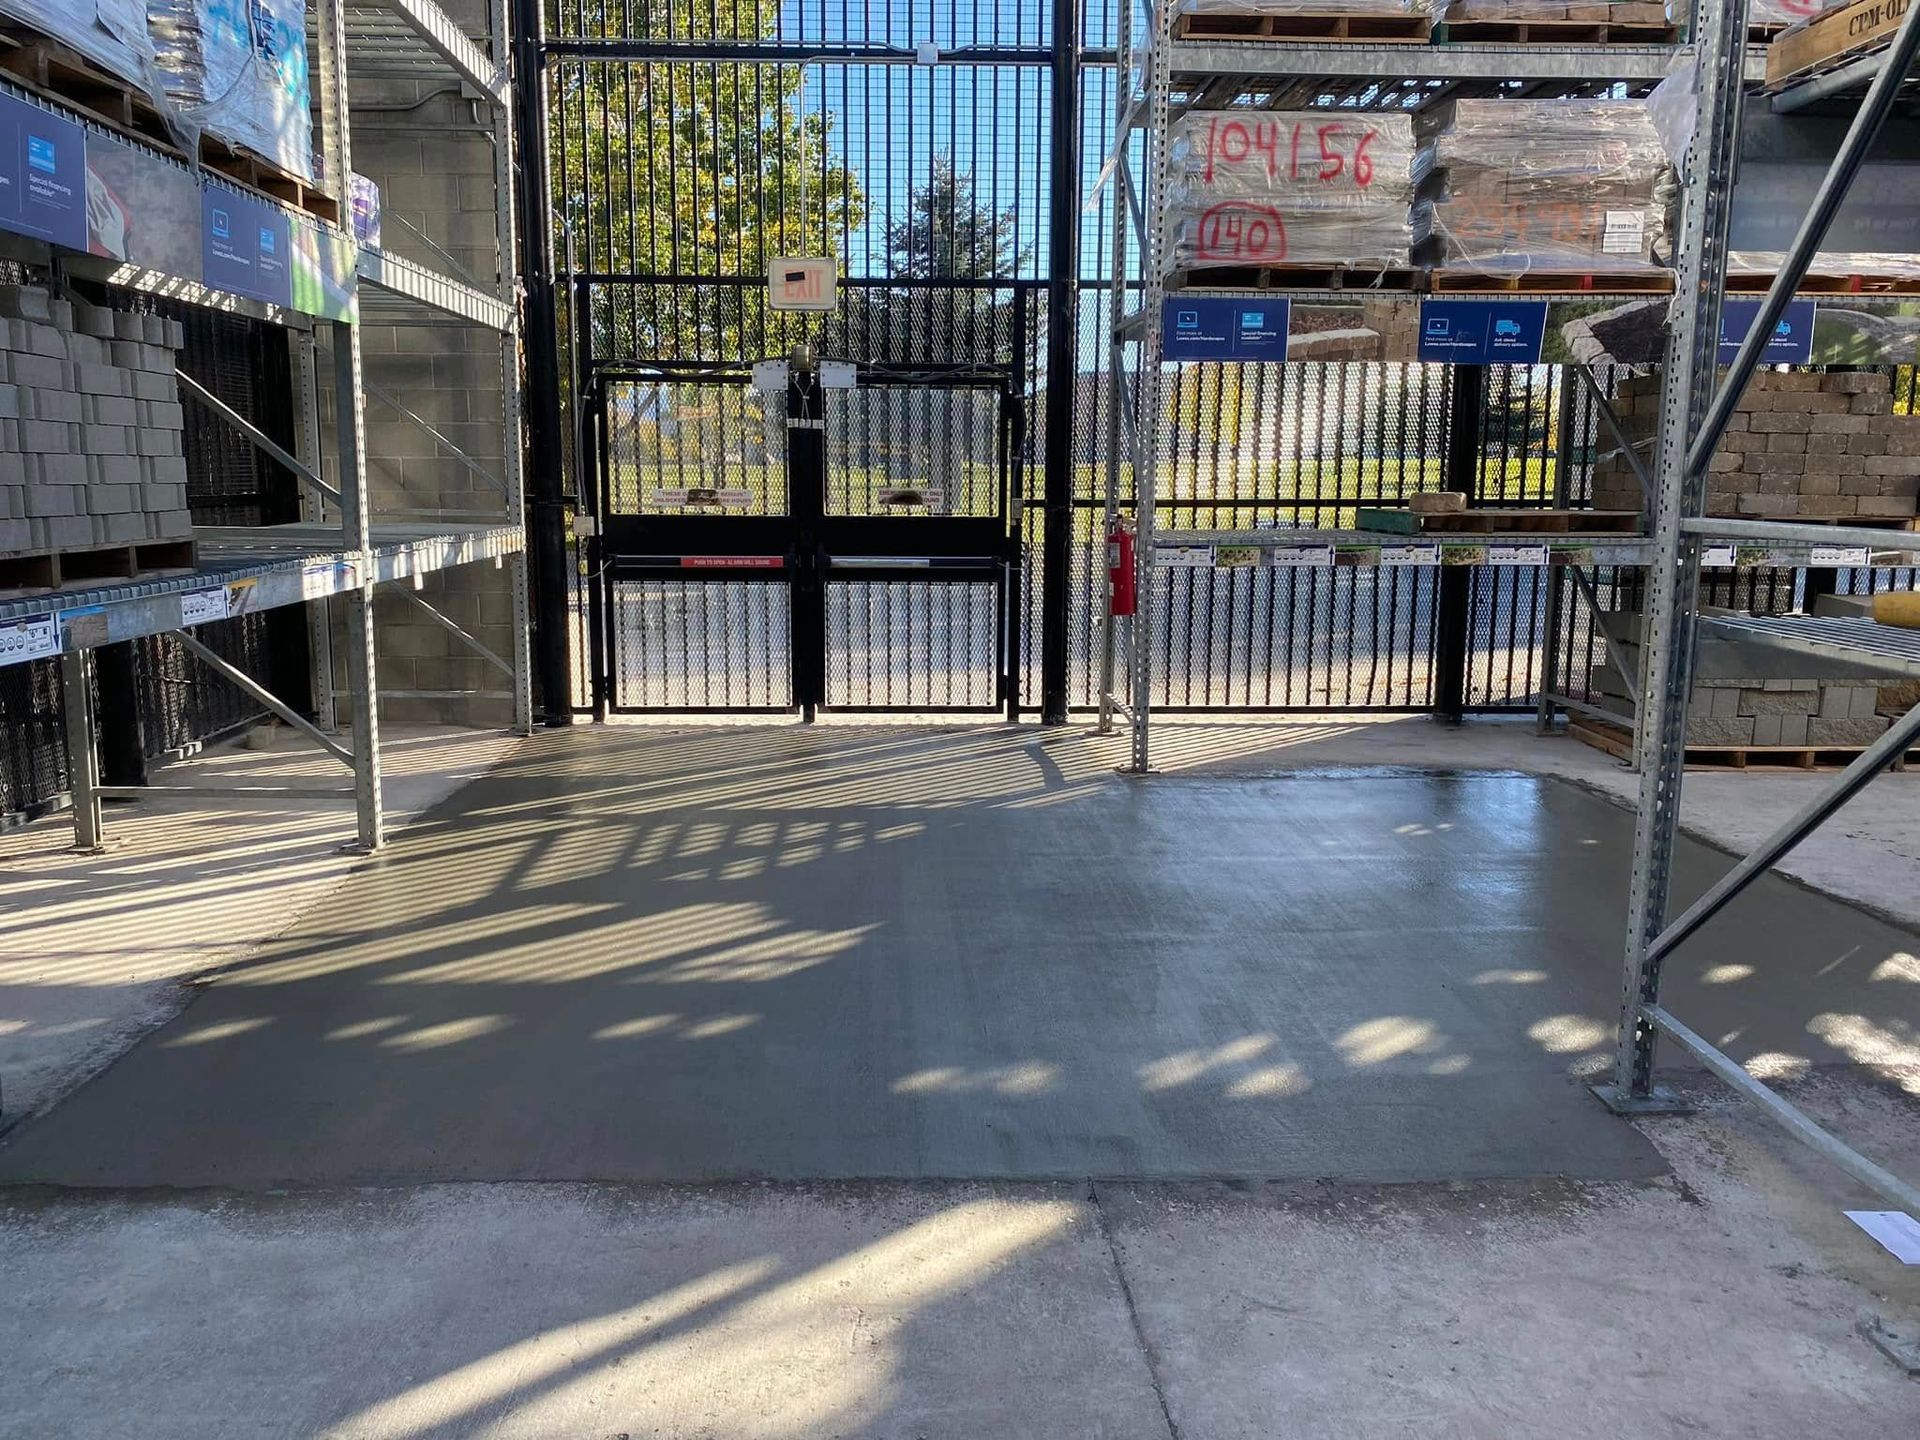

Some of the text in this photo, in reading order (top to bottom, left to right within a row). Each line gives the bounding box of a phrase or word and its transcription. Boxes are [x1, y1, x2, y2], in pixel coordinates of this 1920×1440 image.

[1204, 116, 1379, 189] 104156
[1211, 213, 1270, 256] 140
[783, 269, 825, 298] EXIT
